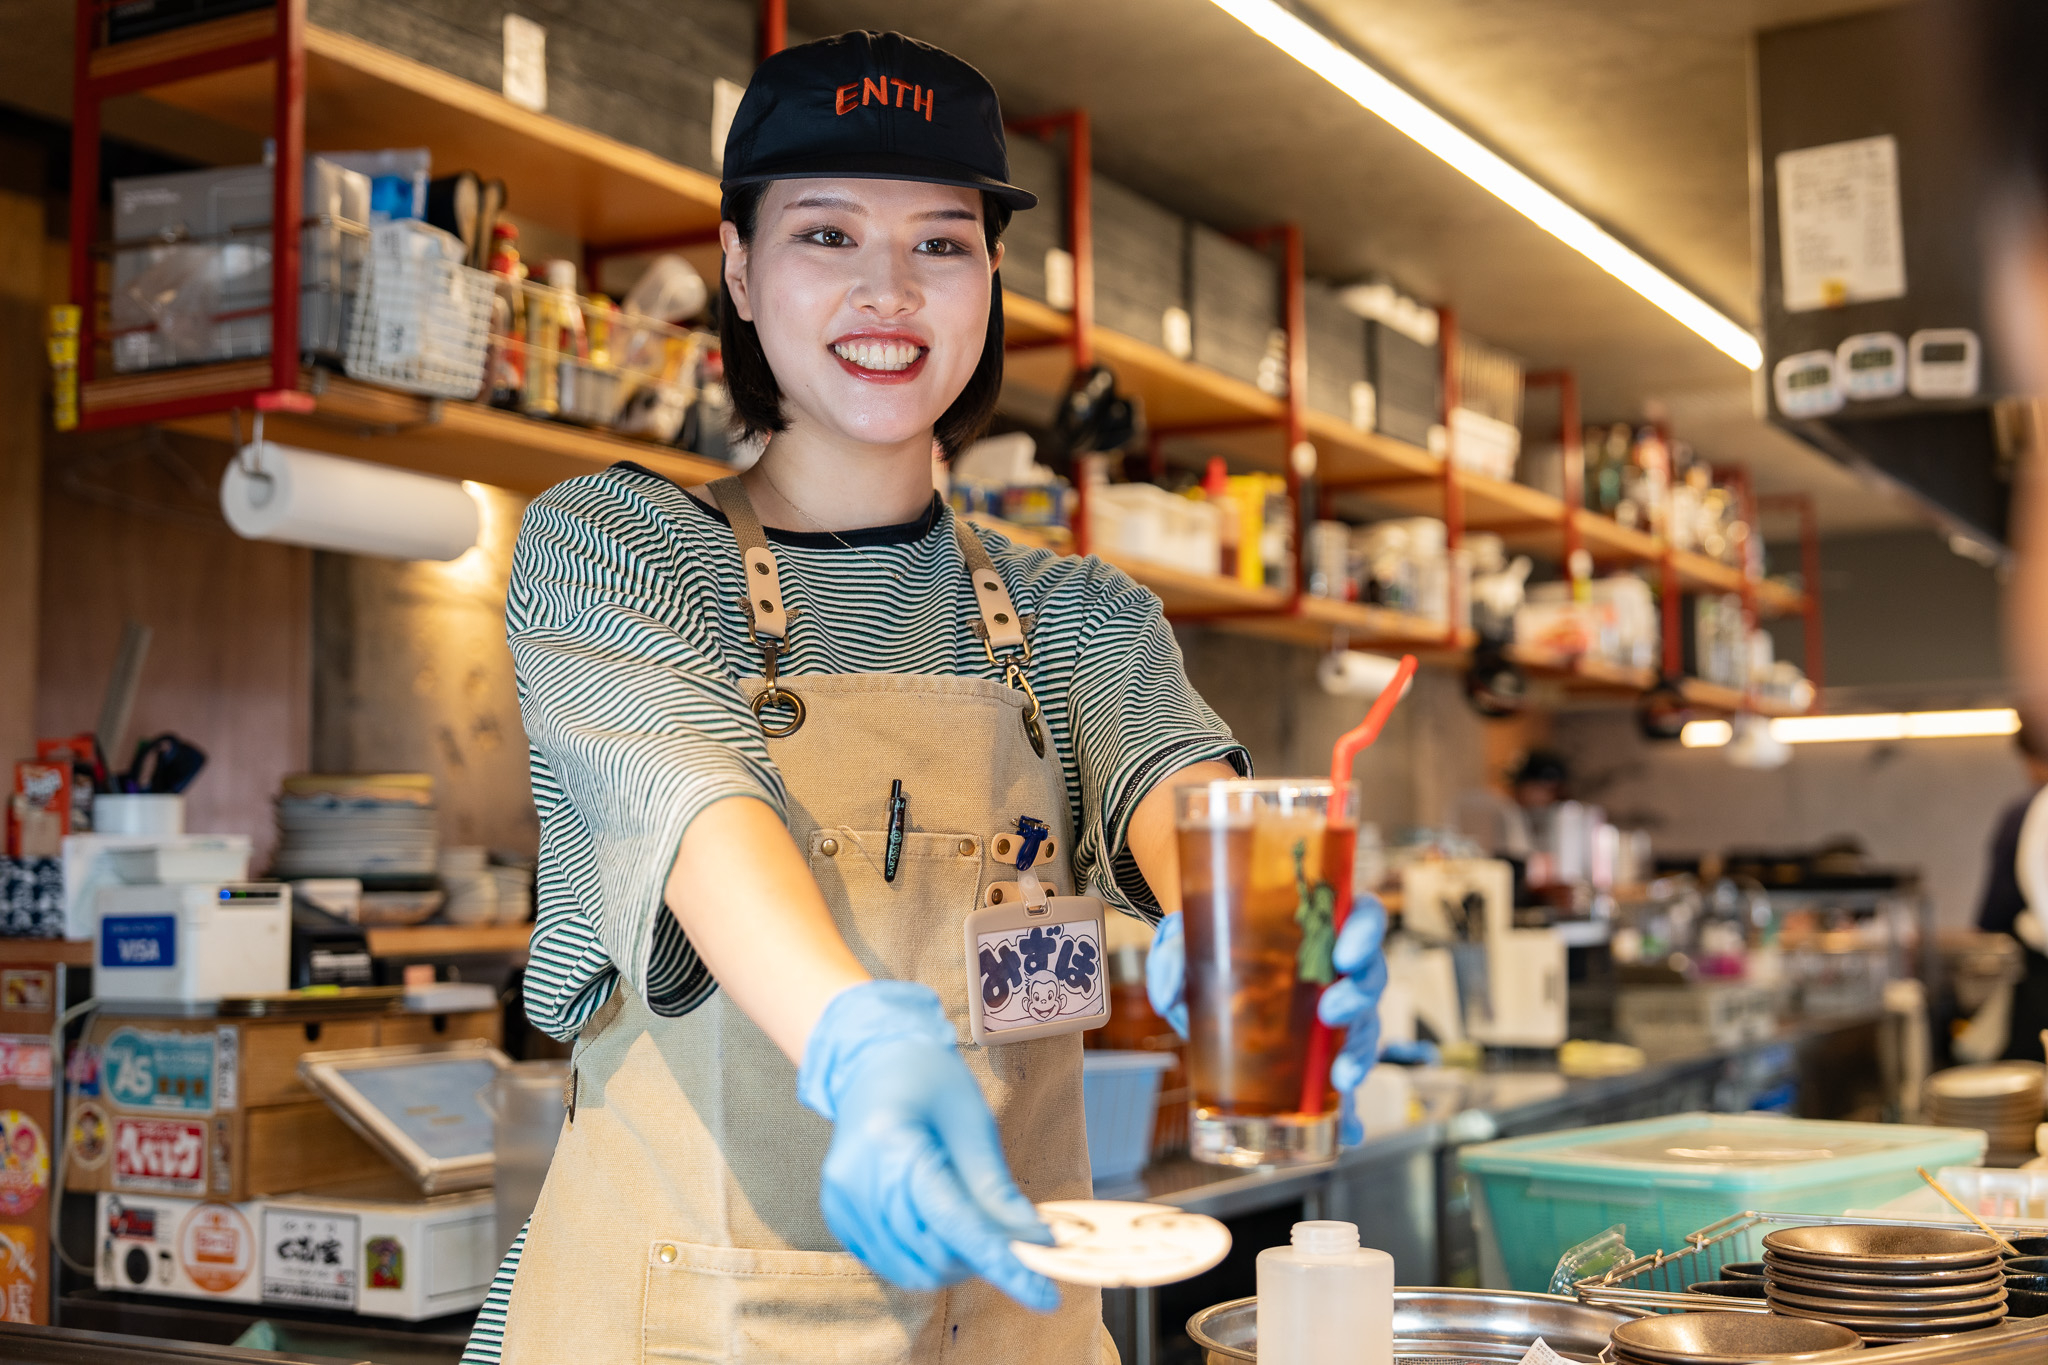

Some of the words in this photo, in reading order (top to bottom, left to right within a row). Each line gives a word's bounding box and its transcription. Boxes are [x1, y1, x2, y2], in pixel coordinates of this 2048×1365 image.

[836, 75, 934, 122] ENTH
[978, 926, 1097, 1009] みずほ
